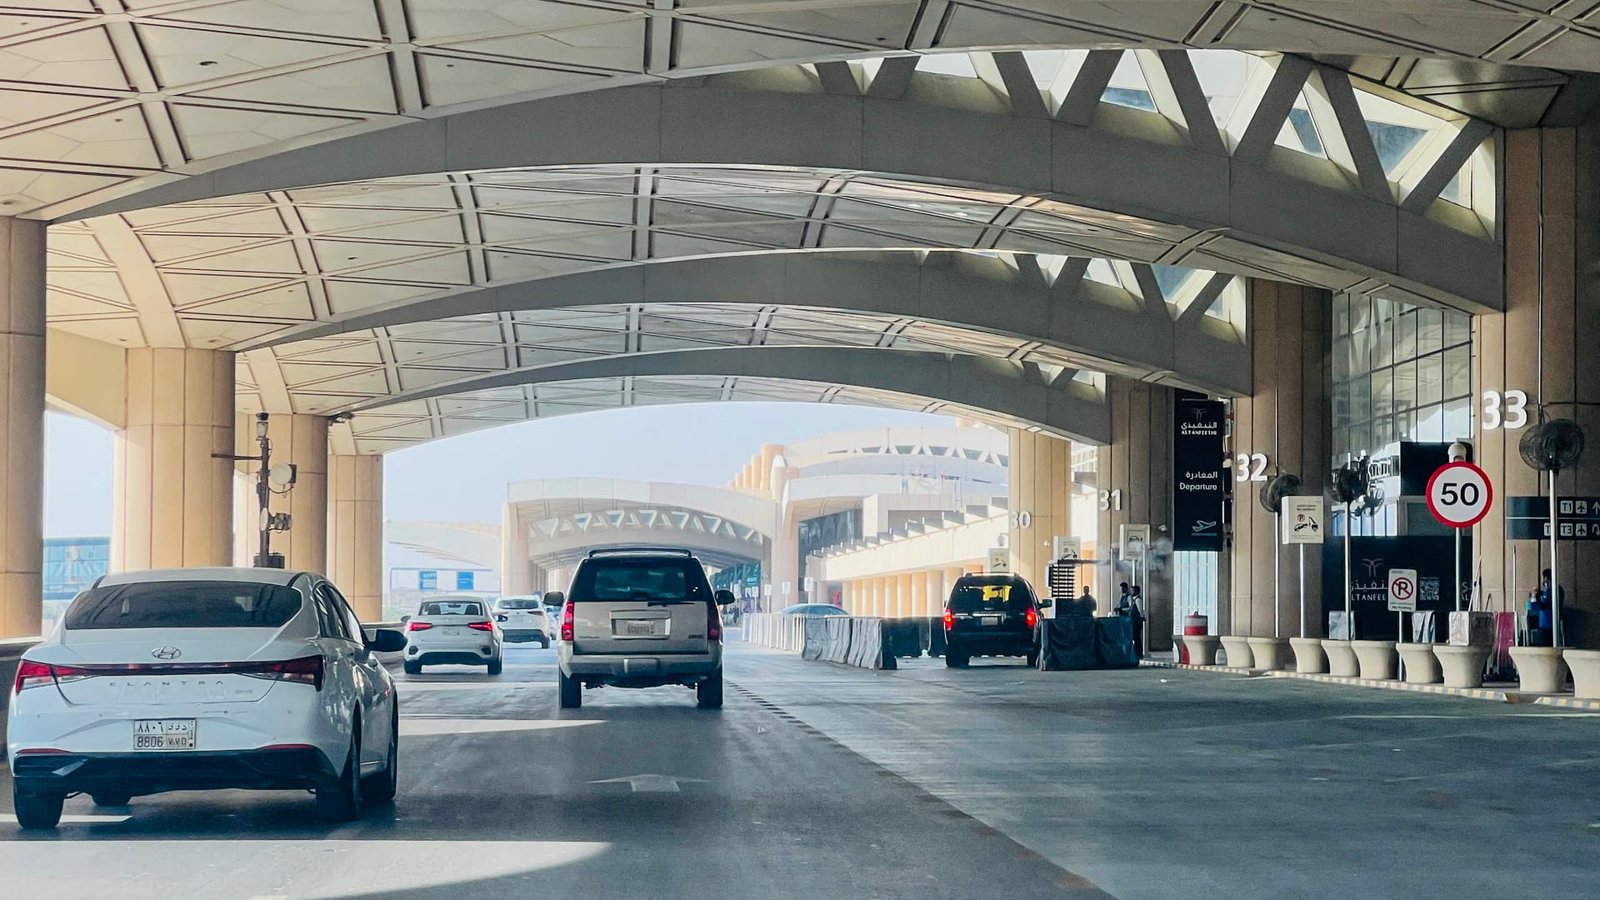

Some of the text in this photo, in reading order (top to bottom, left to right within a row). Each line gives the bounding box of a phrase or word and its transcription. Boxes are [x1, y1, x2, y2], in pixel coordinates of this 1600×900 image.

[1481, 390, 1528, 431] 33
[1236, 453, 1268, 482] 32
[1185, 471, 1218, 480] المغادرة
[1179, 482, 1218, 492] Departure
[1440, 482, 1479, 506] 50
[1099, 489, 1122, 511] 31
[1562, 503, 1572, 512] T1
[1010, 511, 1031, 529] 30
[1561, 525, 1572, 534] T3
[137, 736, 163, 747] 8806
